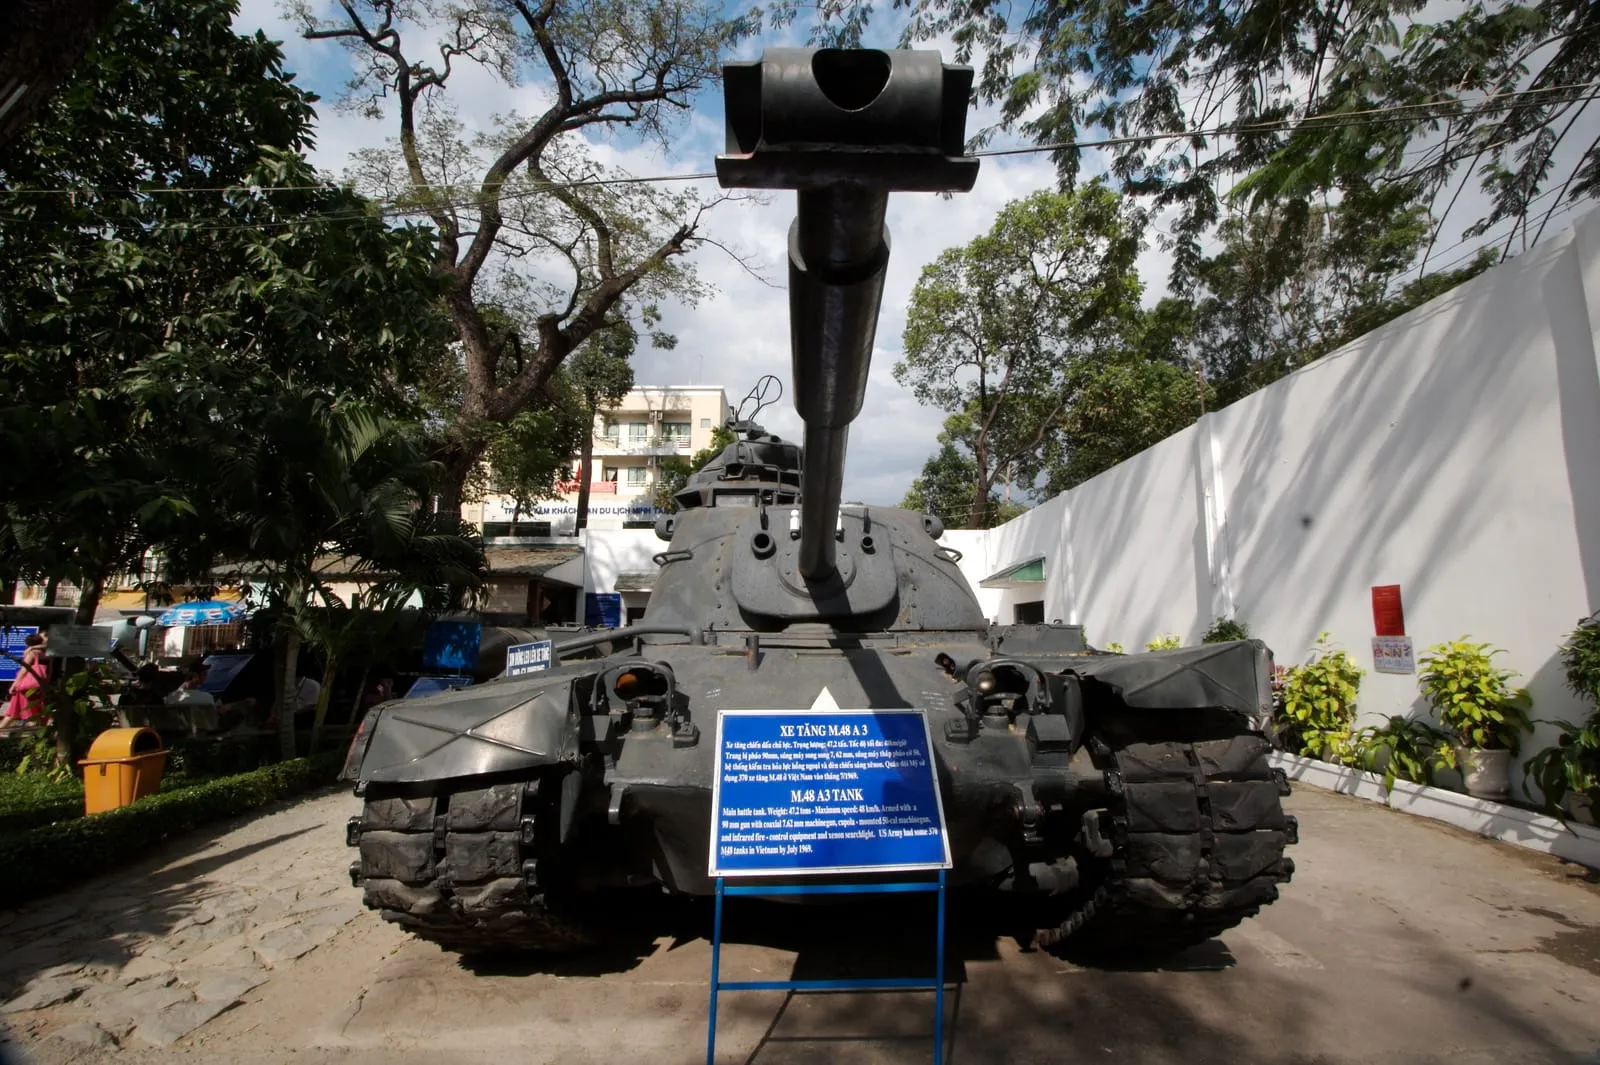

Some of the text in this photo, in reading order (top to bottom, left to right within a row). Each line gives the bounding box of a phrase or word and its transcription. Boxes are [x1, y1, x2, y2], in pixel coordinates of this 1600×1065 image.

[780, 722, 868, 736] XE TĂNG M.48 A 3
[791, 789, 864, 802] M.48 A3 TANK
[767, 807, 788, 816] Weight:
[842, 805, 858, 814] speed:
[721, 834, 731, 842] and
[732, 833, 754, 841] infrared
[755, 833, 765, 841] fire
[770, 832, 788, 840] control
[789, 832, 817, 841] equipment
[818, 831, 827, 839] and
[887, 829, 902, 839] Army
[734, 846, 748, 855] tanks
[756, 846, 779, 854] Vietnam
[786, 845, 798, 855] July
